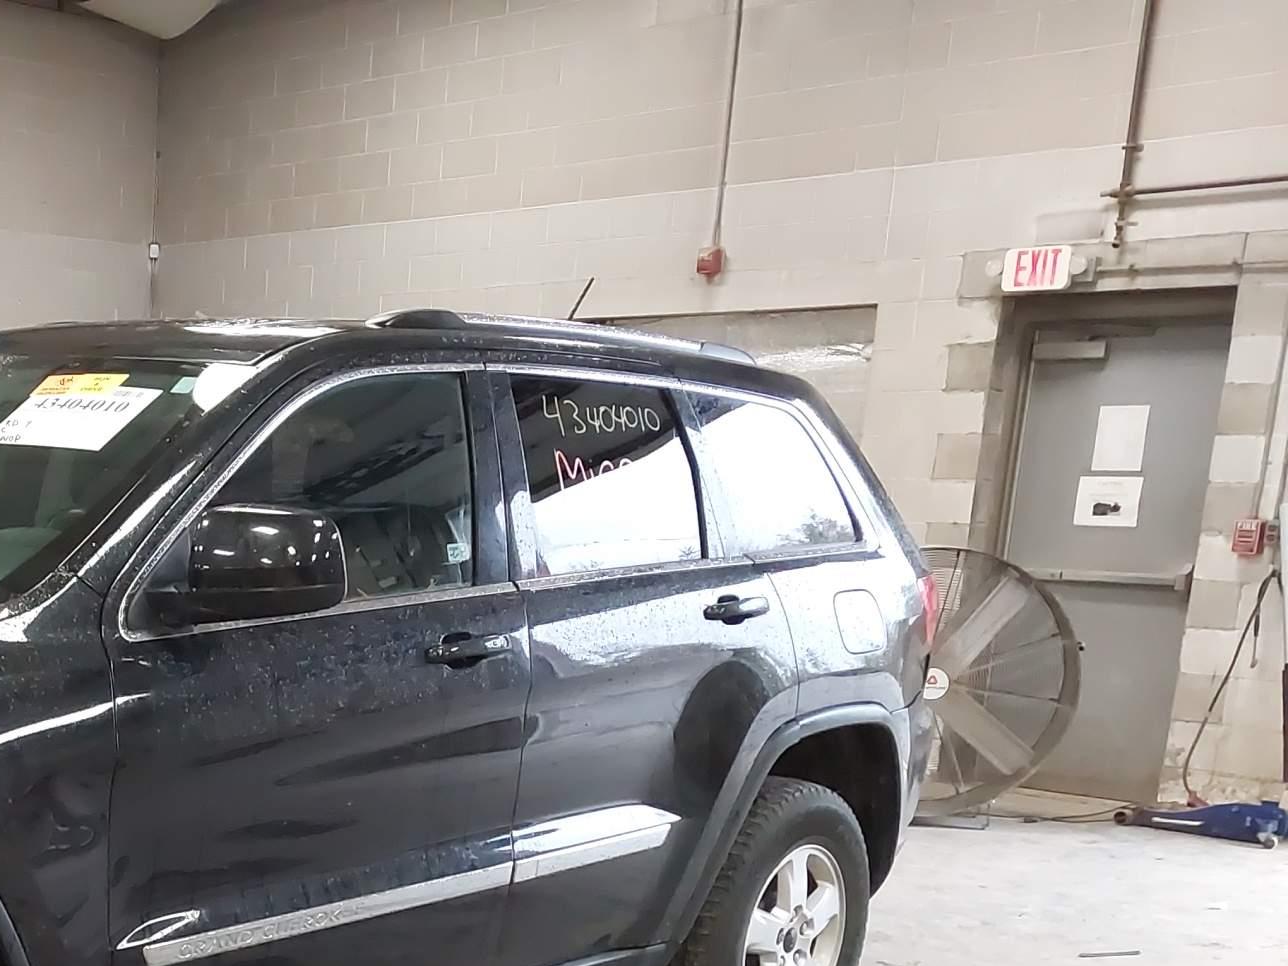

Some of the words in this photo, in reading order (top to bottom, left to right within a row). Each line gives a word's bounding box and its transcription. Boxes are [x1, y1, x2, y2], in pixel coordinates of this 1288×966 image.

[1014, 248, 1062, 287] EXIT
[34, 398, 130, 412] 43404010
[542, 395, 661, 437] 43404010
[176, 930, 256, 960] GRAND
